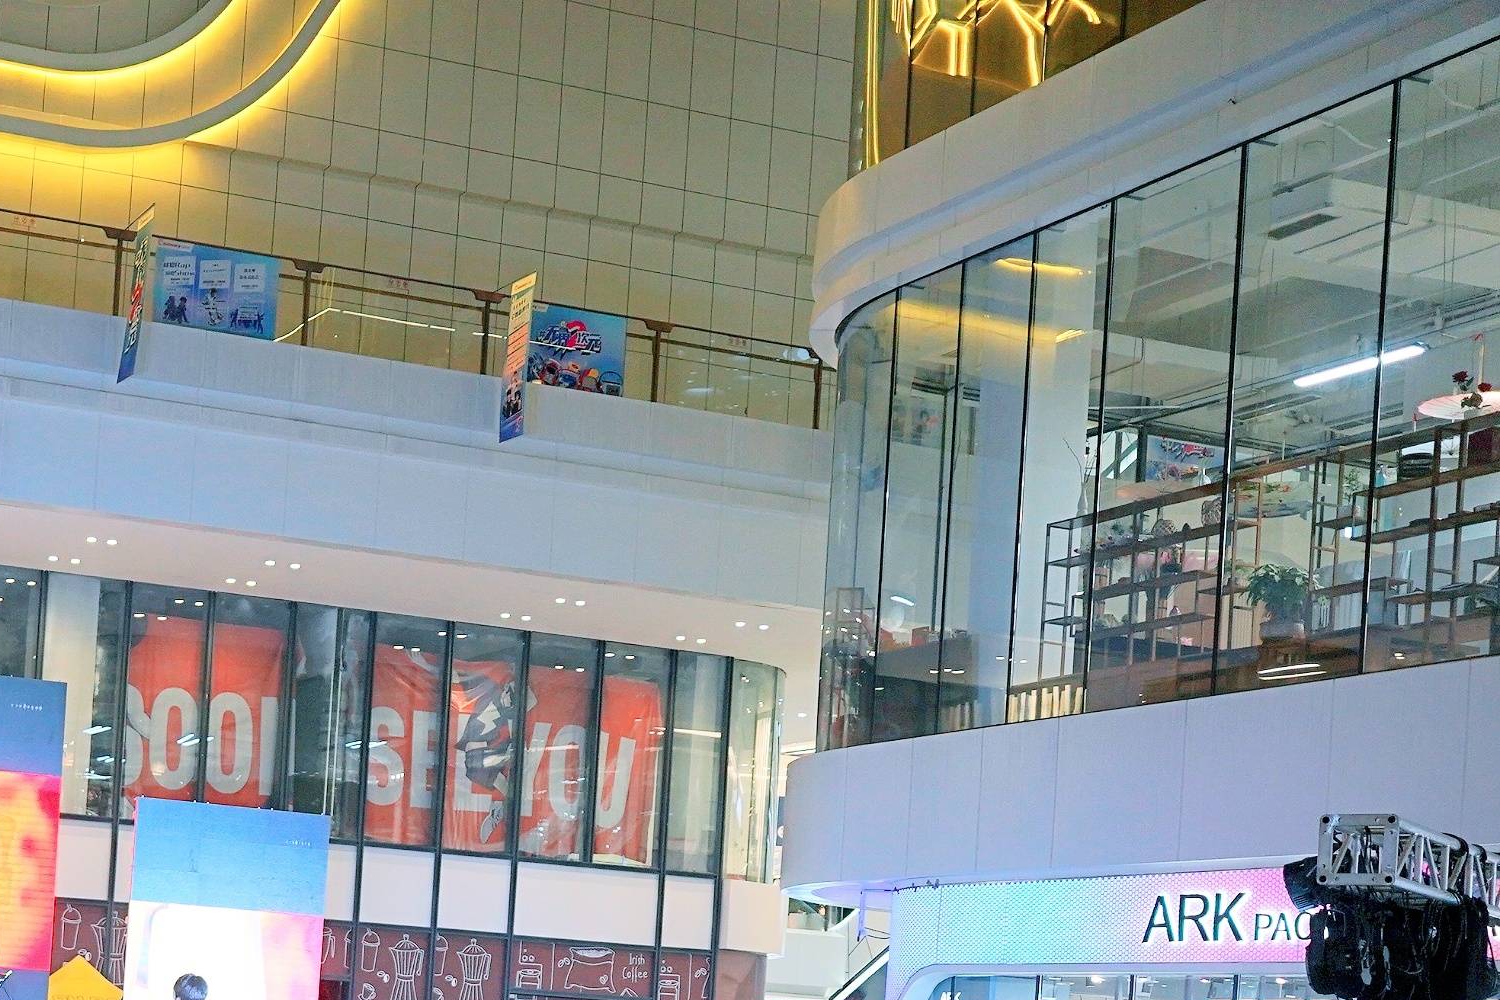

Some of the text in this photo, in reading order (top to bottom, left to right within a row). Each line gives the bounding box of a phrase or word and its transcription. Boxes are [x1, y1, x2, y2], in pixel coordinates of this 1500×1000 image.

[1142, 893, 1313, 943] ARK PAC
[629, 953, 646, 965] Irish
[622, 967, 649, 983] Coffee
